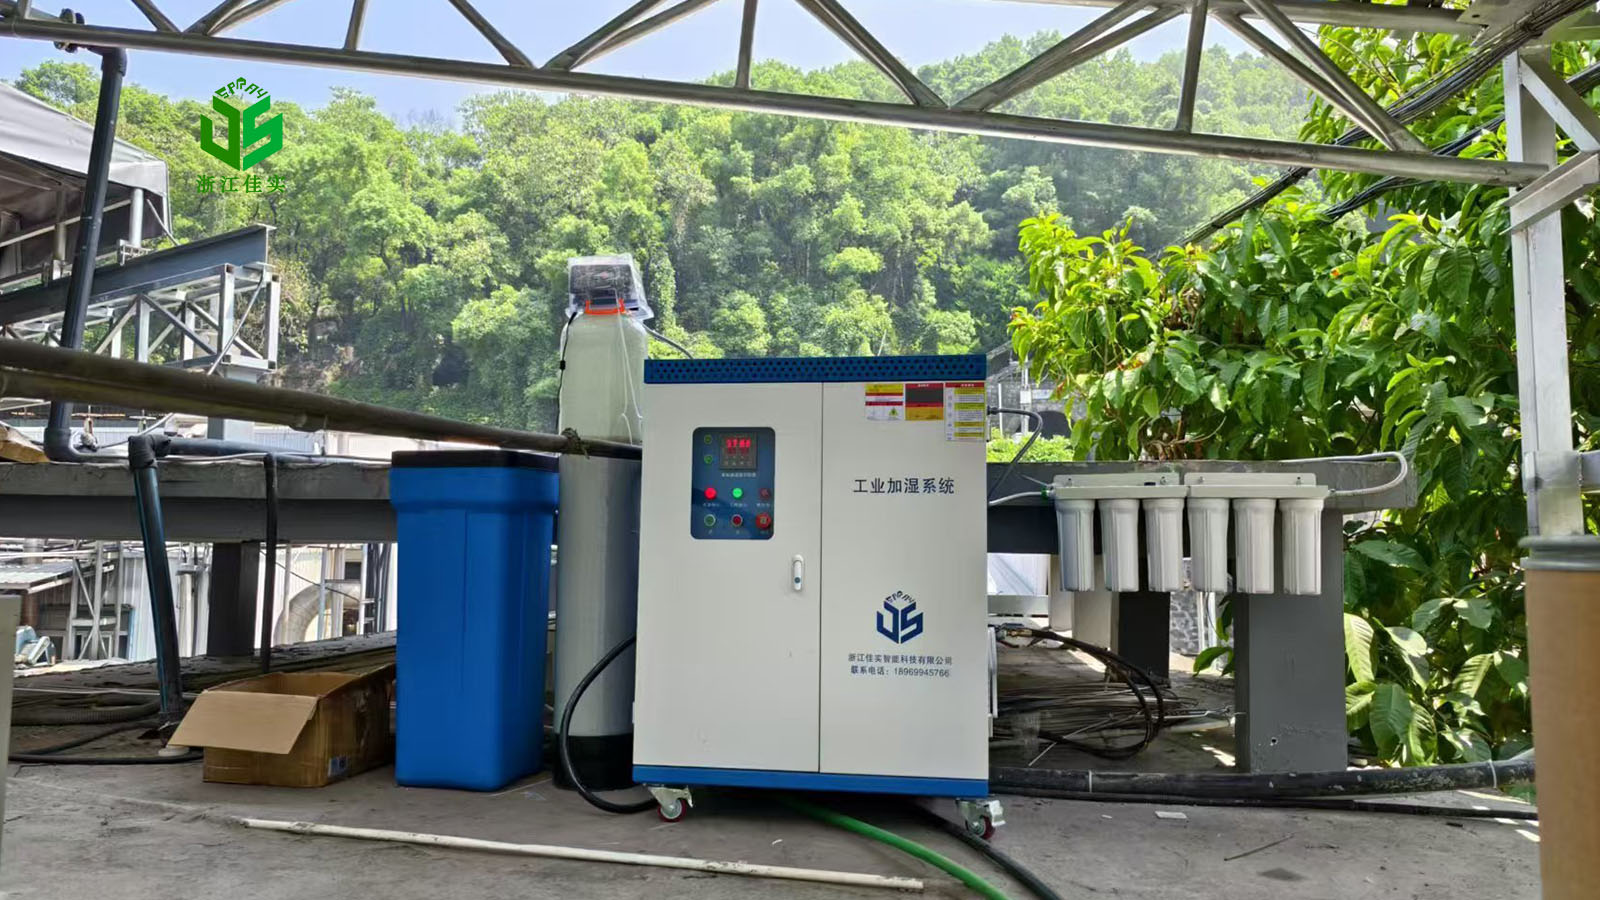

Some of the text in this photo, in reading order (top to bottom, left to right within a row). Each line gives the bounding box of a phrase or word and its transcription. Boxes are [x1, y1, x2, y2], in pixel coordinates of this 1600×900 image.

[853, 476, 955, 495] 工业加湿系统
[848, 653, 952, 666] 浙江佳实智能科技有限公司
